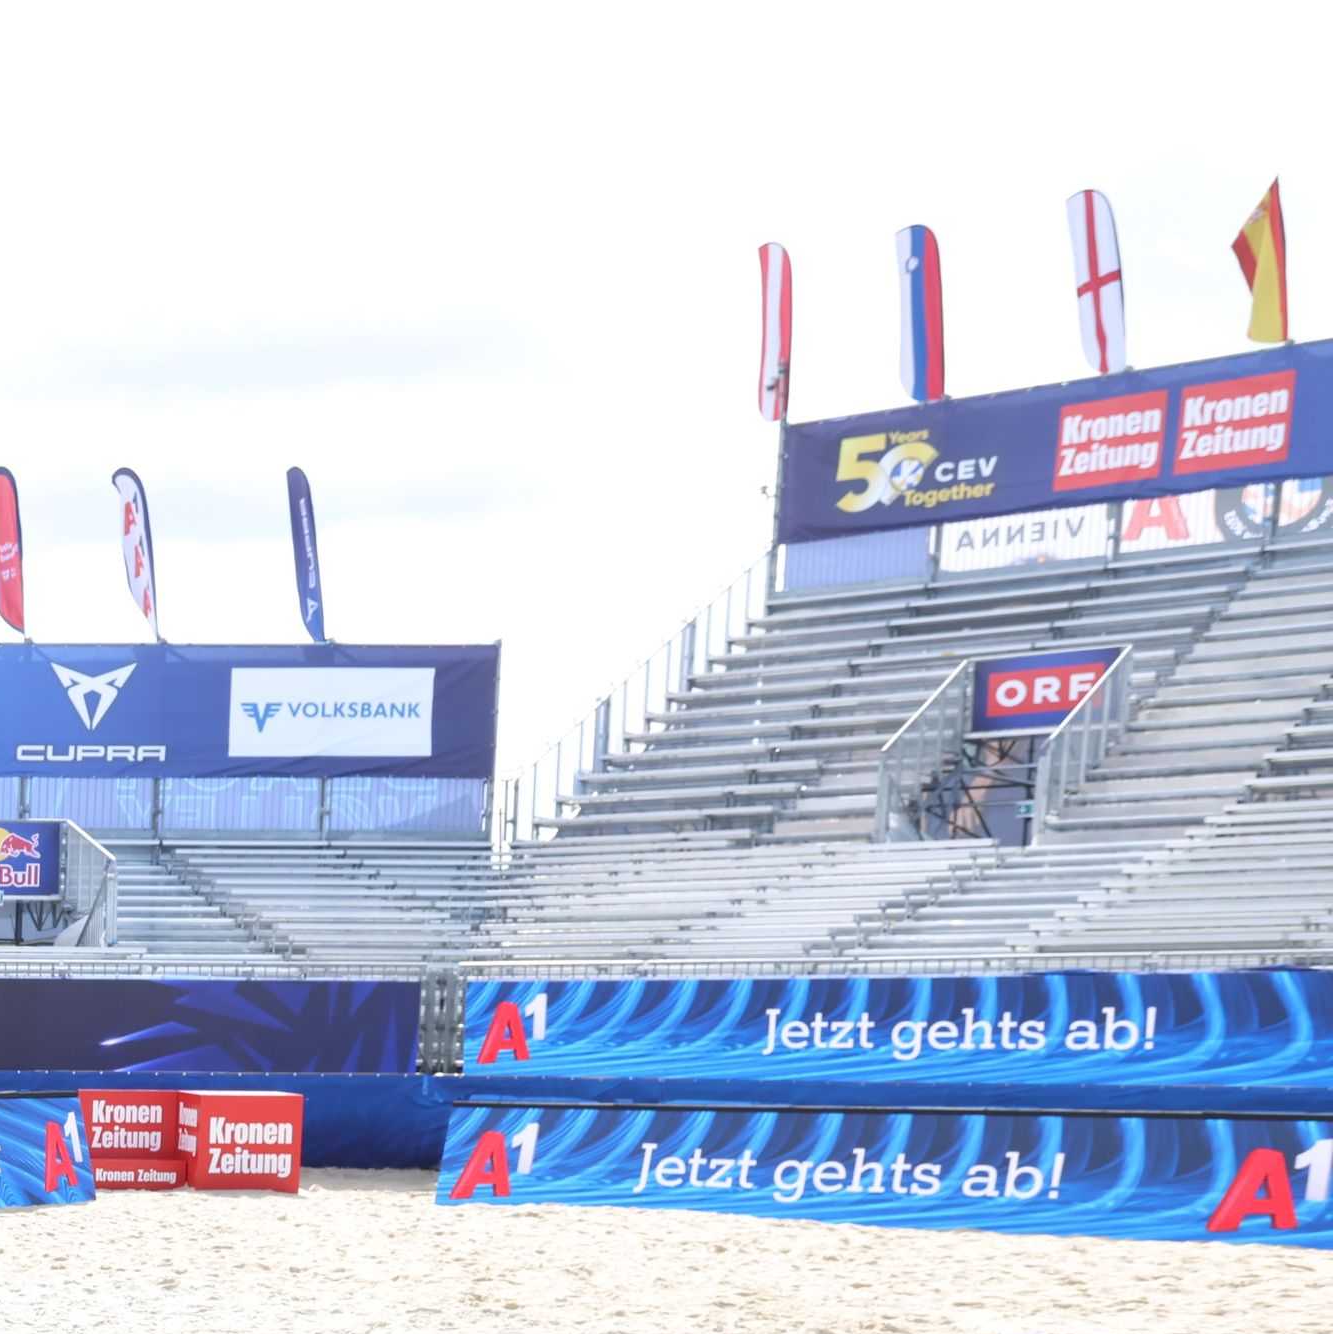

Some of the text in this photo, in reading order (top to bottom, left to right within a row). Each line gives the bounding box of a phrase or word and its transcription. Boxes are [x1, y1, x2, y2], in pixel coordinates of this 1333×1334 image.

[1184, 388, 1290, 428] Kronen
[889, 429, 930, 445] Years
[1061, 407, 1162, 446] Kronen
[1179, 422, 1286, 460] Zeitung
[934, 455, 999, 482] CEV
[1058, 441, 1159, 477] Zeitung
[904, 482, 996, 508] Together
[995, 671, 1097, 707] ORF
[287, 701, 421, 720] VOLKSBANK
[16, 744, 166, 762] CUPRA
[477, 992, 548, 1064] A1
[761, 1006, 1157, 1061] Jetzt gehts ab!
[91, 1100, 162, 1124] Kronen
[91, 1126, 161, 1152] Zeitung
[209, 1117, 293, 1144] Kronen
[44, 1112, 83, 1193] A1
[208, 1147, 293, 1178] Zeitung
[449, 1122, 540, 1200] A1
[95, 1168, 177, 1184] Kronen Zeitung
[634, 1143, 1065, 1203] Jetzt gehts ab!
[1206, 1139, 1333, 1232] A1
